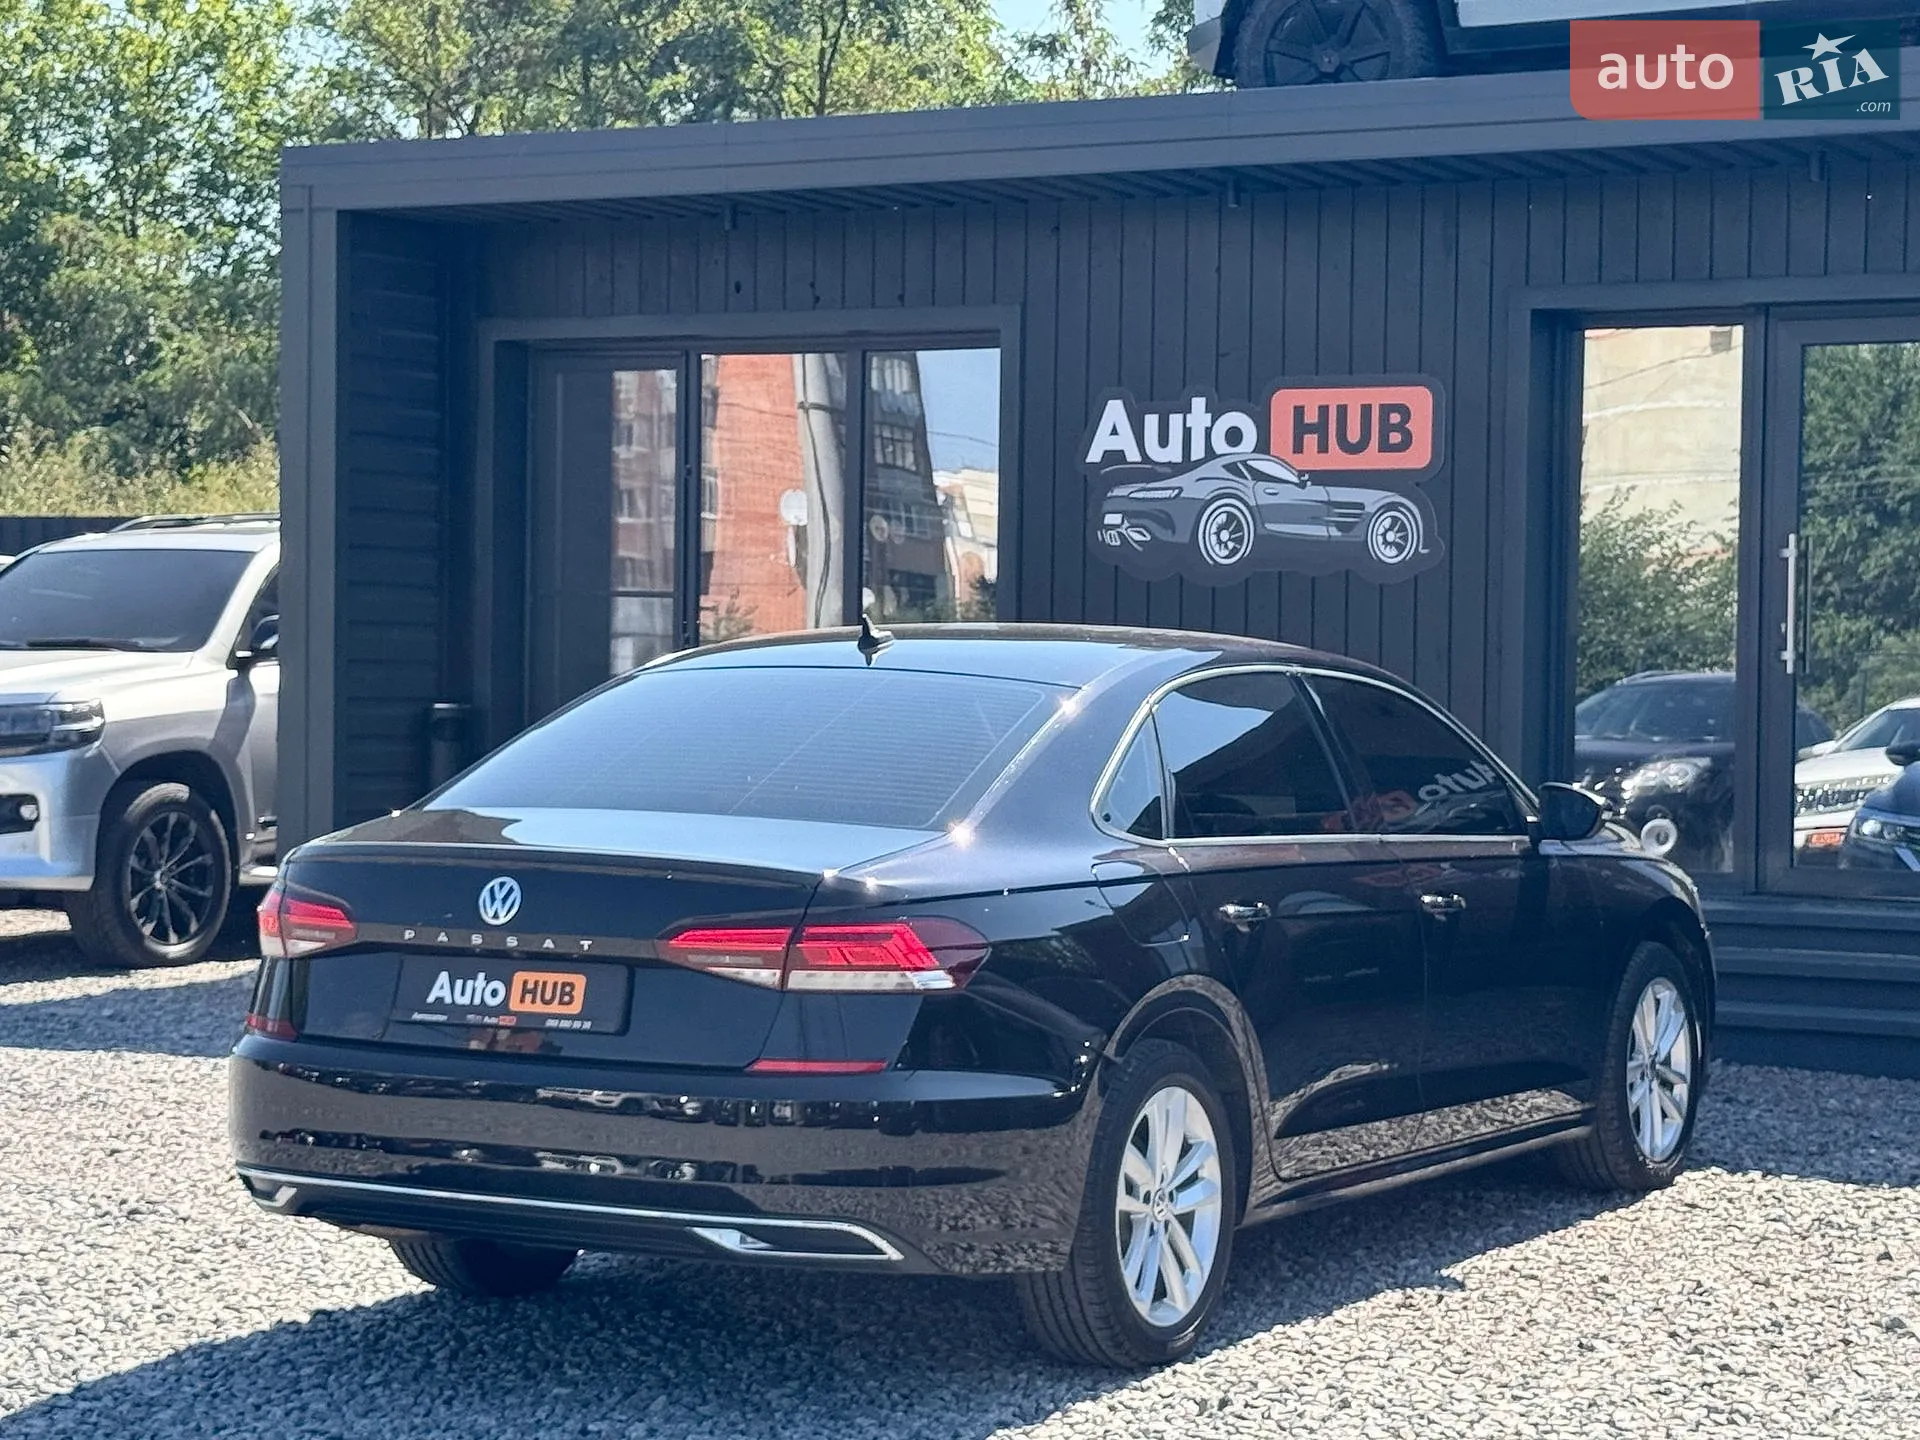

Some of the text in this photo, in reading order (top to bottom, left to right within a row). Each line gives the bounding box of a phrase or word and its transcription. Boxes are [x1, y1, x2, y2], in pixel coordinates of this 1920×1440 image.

[1085, 396, 1414, 463] Auto HUB
[403, 929, 593, 952] PASSAT
[425, 970, 576, 1008] Auto HUB
